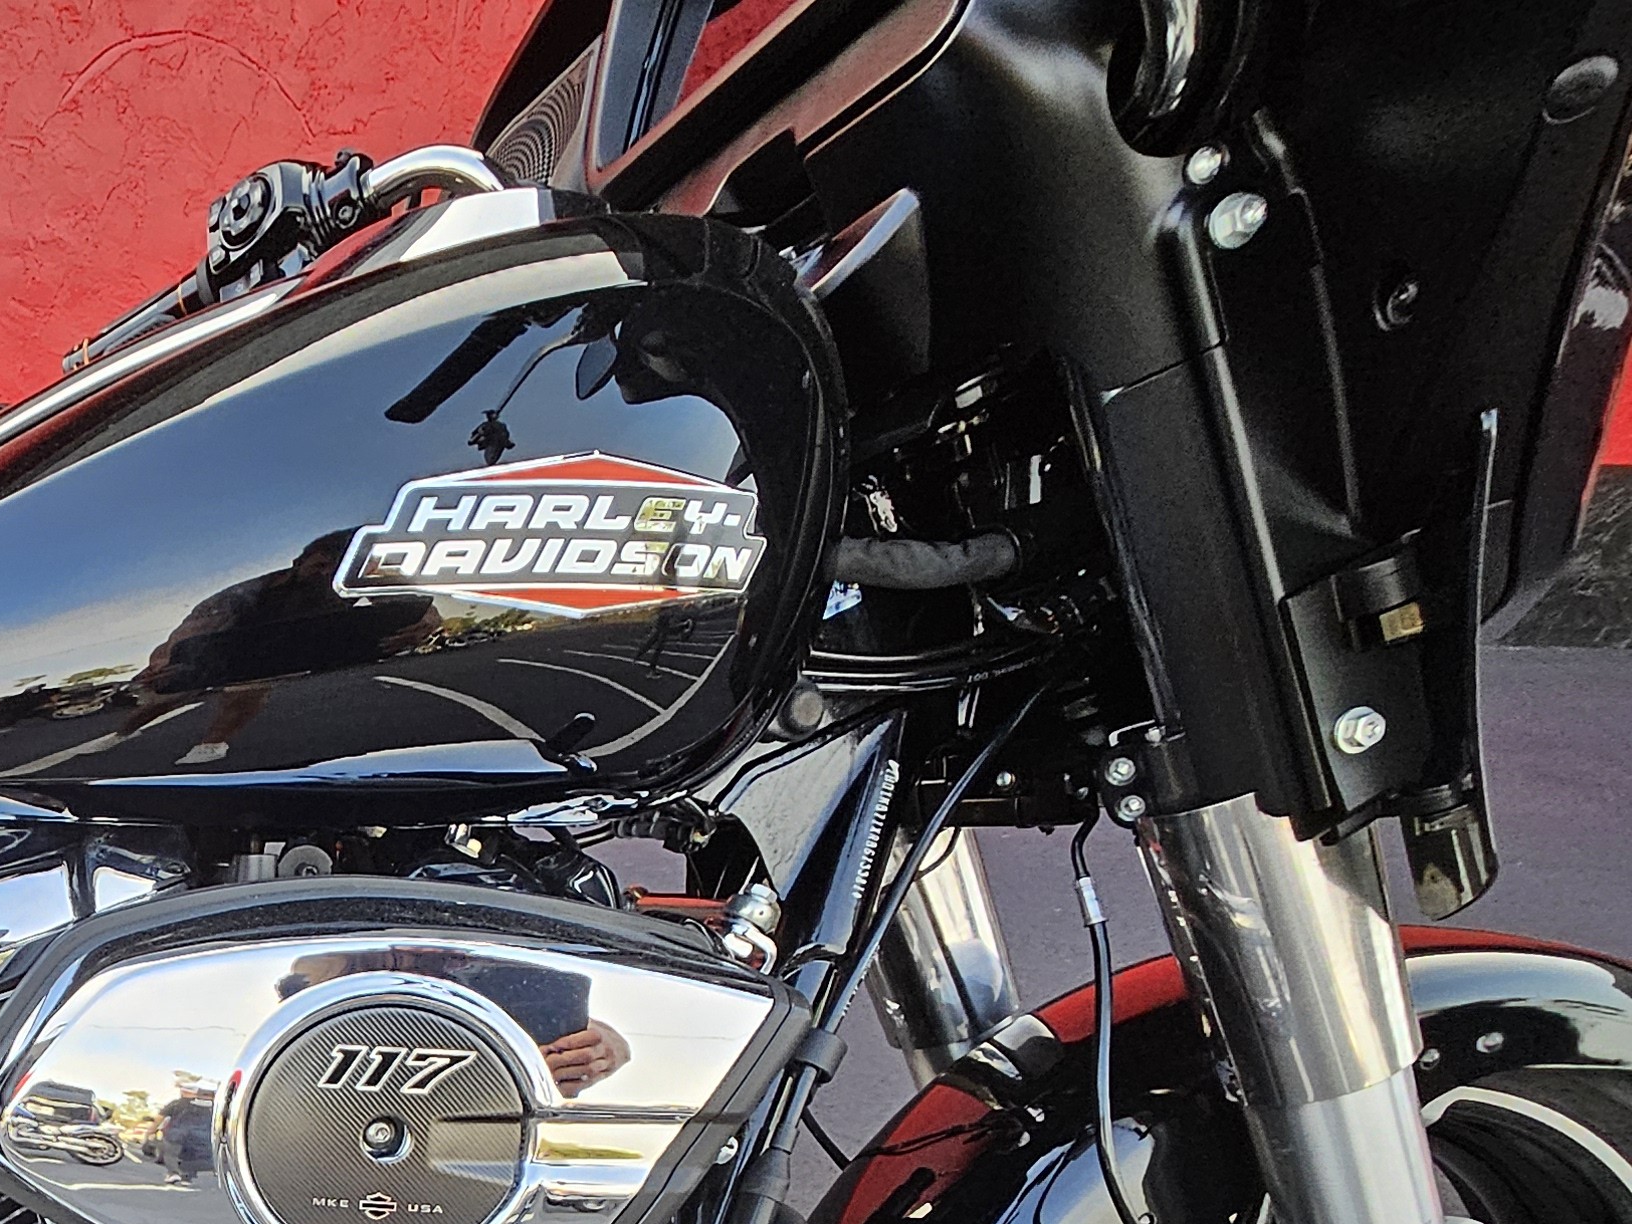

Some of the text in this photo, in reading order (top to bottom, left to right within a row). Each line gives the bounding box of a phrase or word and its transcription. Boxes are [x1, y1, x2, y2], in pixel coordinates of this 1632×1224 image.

[407, 494, 740, 533] HARLEY-
[358, 539, 752, 581] DAVIDSON
[318, 1043, 478, 1095] 117
[312, 1197, 444, 1214] MKE USA
